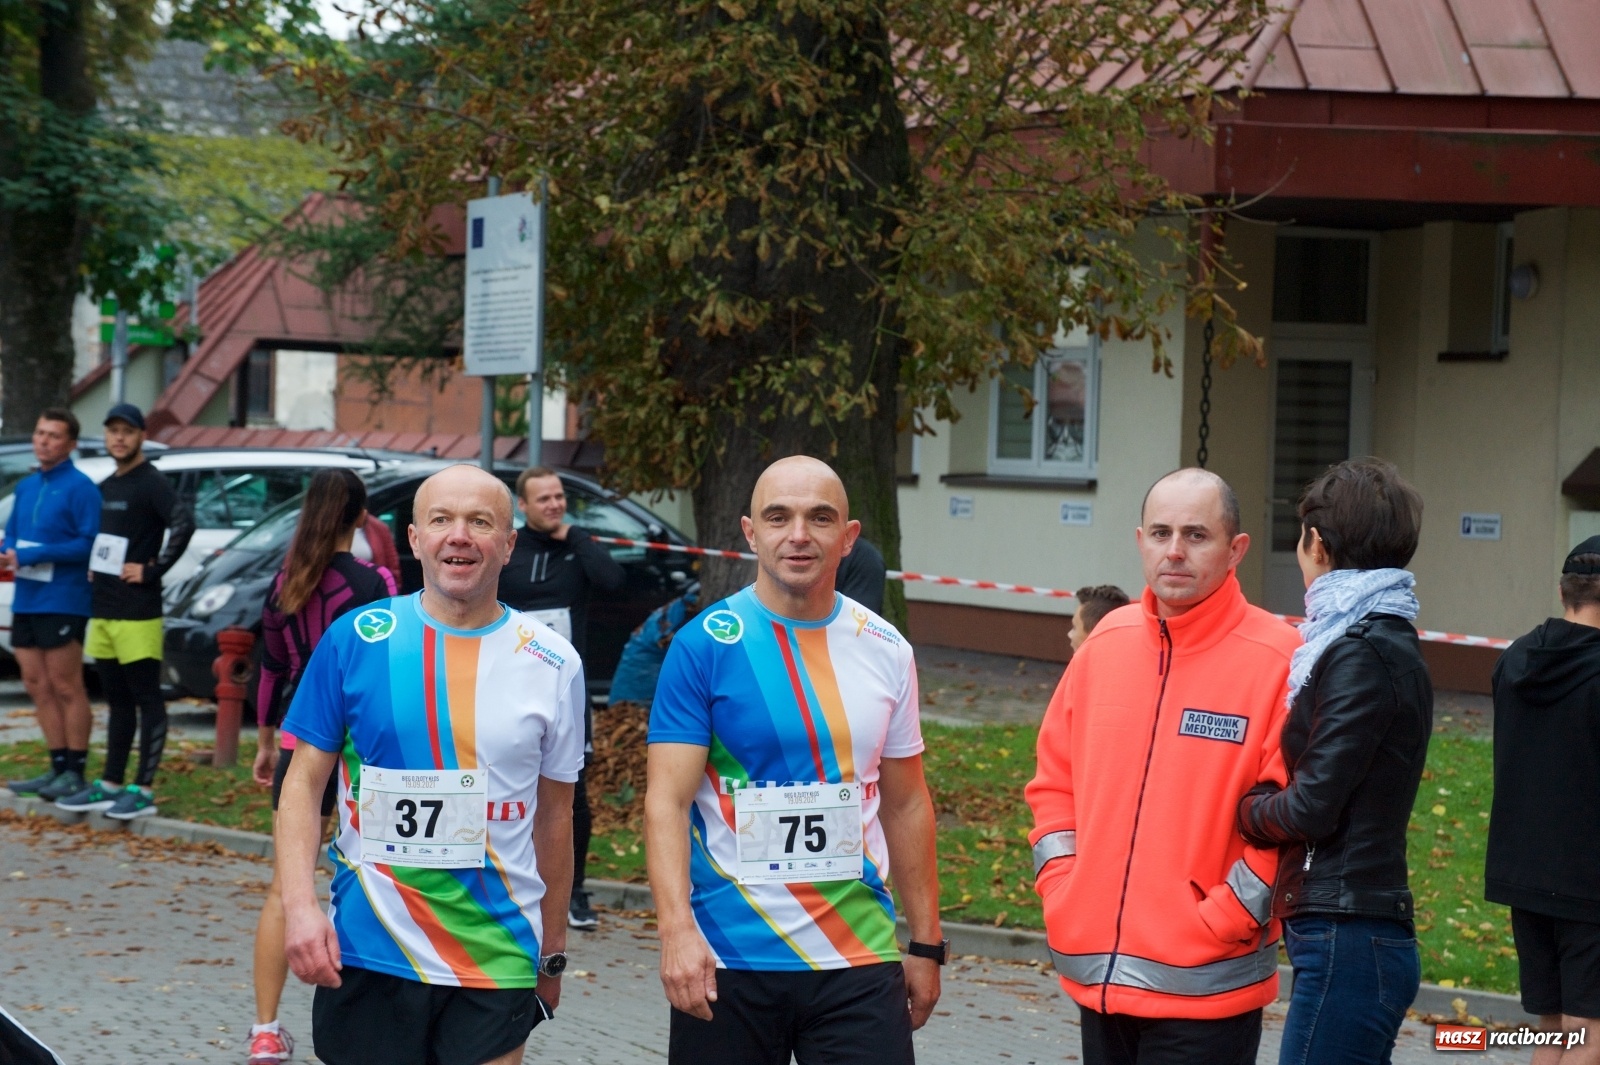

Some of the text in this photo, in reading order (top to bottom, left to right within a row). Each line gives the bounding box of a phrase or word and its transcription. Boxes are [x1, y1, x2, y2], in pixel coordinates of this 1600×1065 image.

[865, 621, 901, 643] Dystans
[529, 640, 566, 665] Dystans
[1184, 723, 1239, 739] MEDYCZNY
[1188, 713, 1239, 729] RATOWNIK
[405, 780, 436, 788] 19.09.2021
[395, 798, 443, 839] 37
[779, 814, 827, 854] 75
